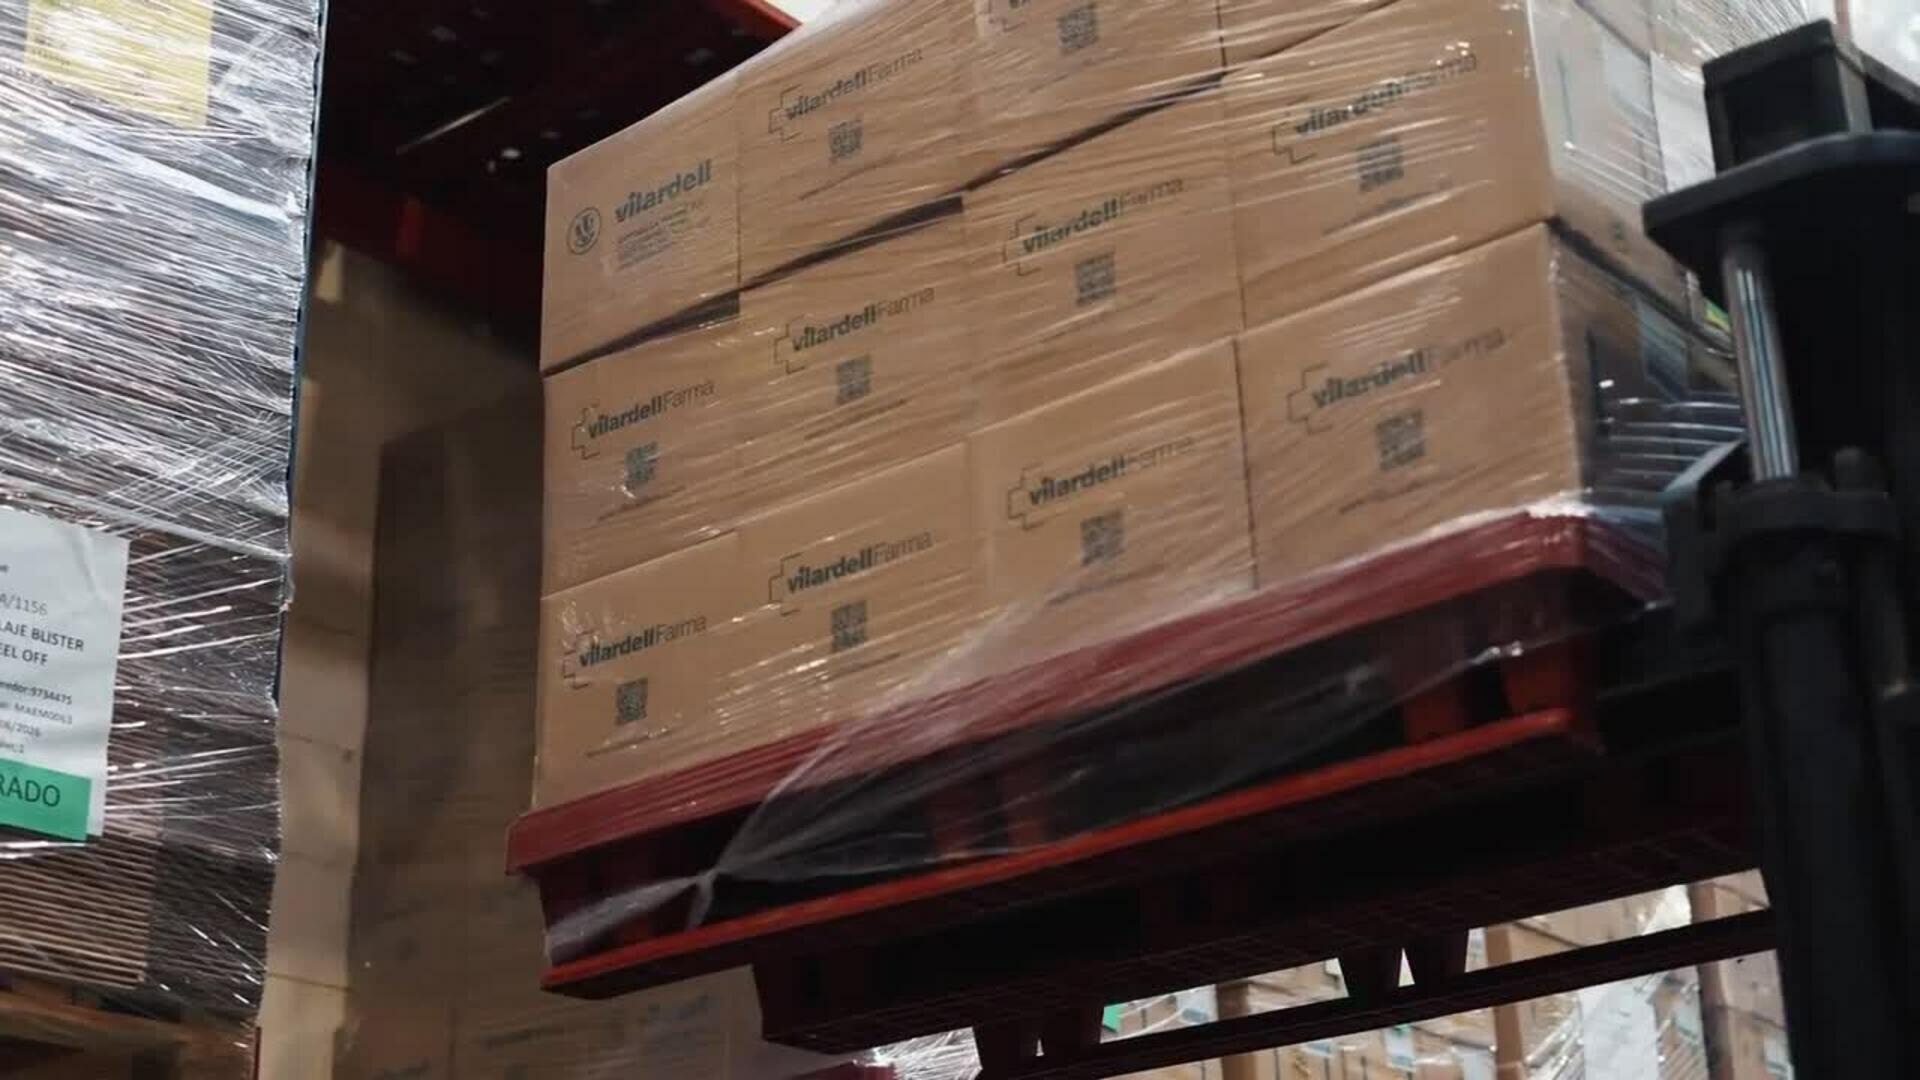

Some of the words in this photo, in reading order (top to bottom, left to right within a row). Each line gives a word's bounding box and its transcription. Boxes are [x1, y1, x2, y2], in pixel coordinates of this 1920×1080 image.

[614, 159, 712, 223] vilardell
[792, 287, 936, 352] vilardellFarma
[588, 378, 715, 439] vilardellFarma
[787, 532, 934, 594] vilardellFarma
[0, 620, 27, 637] AJE
[31, 627, 84, 652] BLISTER
[22, 649, 48, 666] OFF
[579, 615, 707, 668] vilardellFarma
